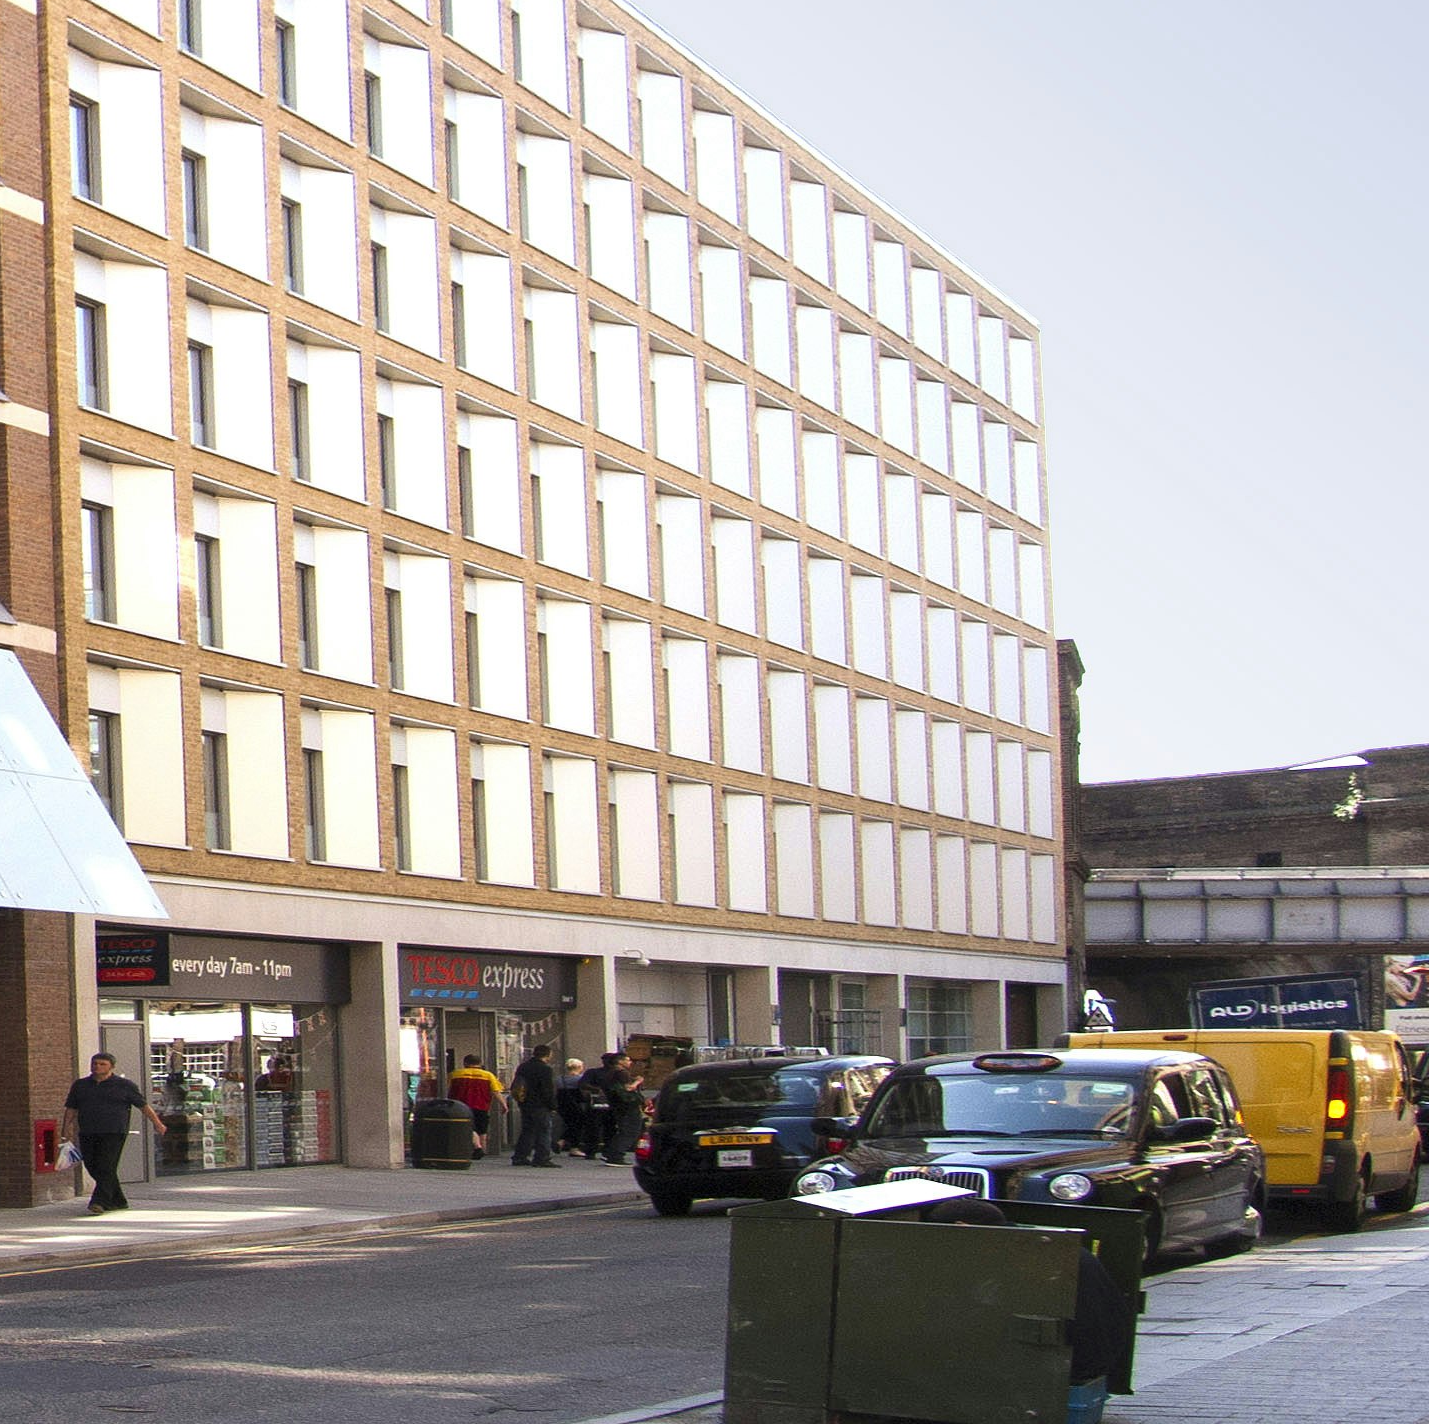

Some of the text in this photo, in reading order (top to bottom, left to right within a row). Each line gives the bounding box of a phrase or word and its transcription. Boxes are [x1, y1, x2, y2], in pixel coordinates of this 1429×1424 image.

[172, 957, 205, 977] every
[206, 956, 228, 977] day
[229, 956, 253, 975] 7am
[262, 959, 292, 980] 11pm
[407, 955, 544, 998] TESCO express
[1261, 999, 1348, 1014] logistics
